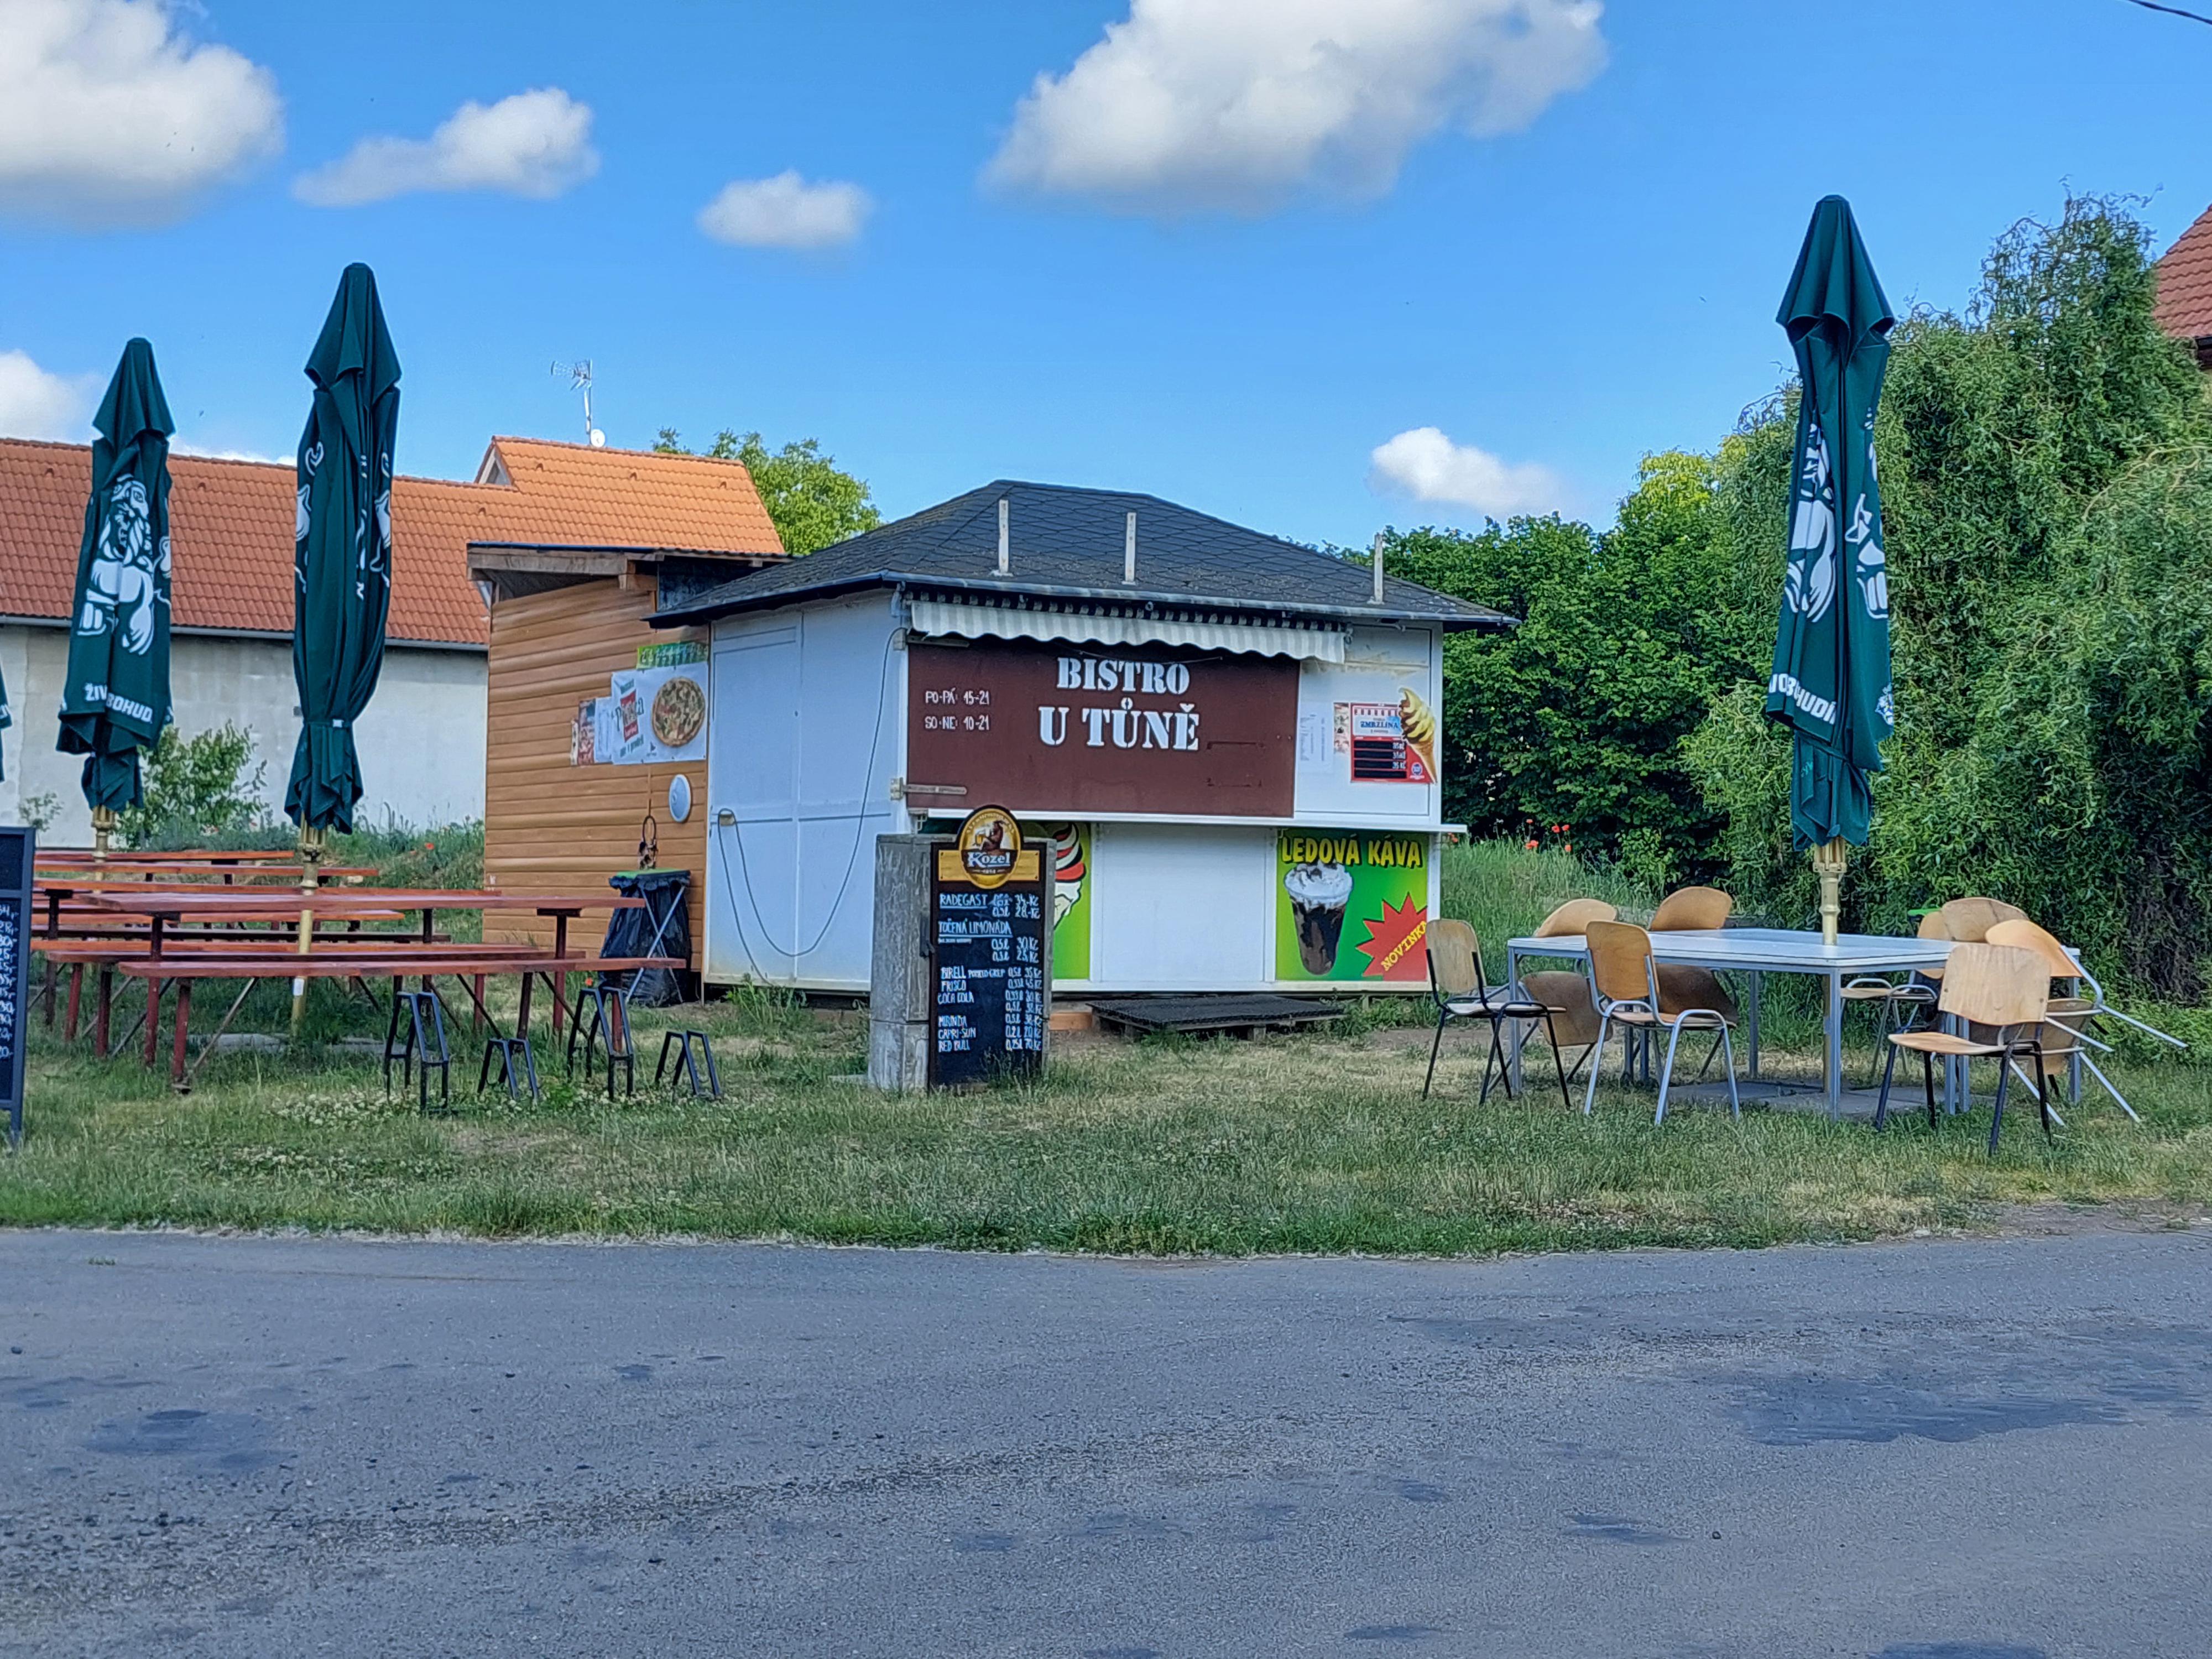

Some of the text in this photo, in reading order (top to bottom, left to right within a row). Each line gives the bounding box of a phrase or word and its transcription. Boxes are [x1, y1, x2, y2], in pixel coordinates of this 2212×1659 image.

[1057, 656, 1190, 694] BISTRO
[963, 690, 989, 705] 15-21
[963, 714, 989, 731] 10-21
[1038, 697, 1199, 750] U TŮNĚ
[1282, 834, 1421, 868] LEDOVÁ KÁVA
[967, 852, 1011, 868] Kozel
[940, 893, 988, 906] RADEGAST
